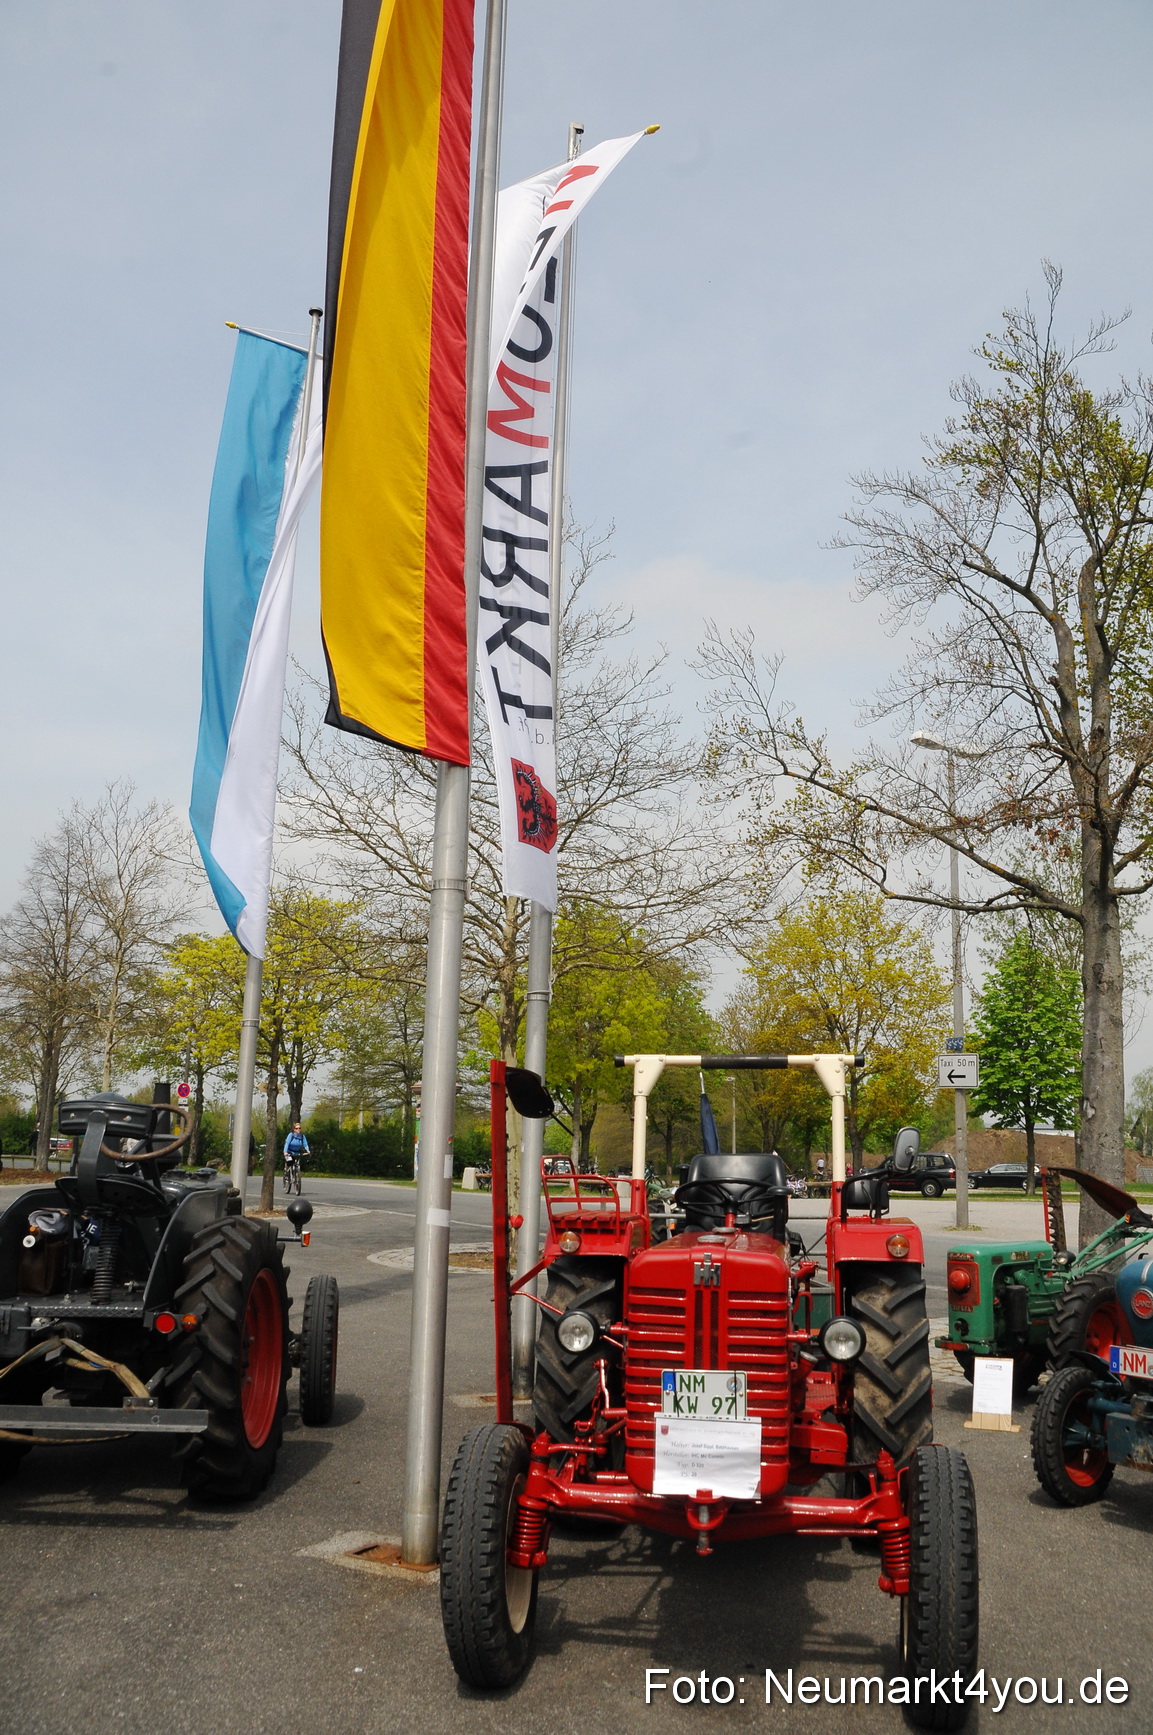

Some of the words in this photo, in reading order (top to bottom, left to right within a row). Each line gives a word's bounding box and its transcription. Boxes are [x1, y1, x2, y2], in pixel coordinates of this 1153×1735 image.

[940, 1059, 953, 1067] Taxi
[957, 1059, 967, 1067] 50
[1123, 1351, 1147, 1375] NM
[667, 1383, 673, 1391] D
[680, 1375, 705, 1393] NM
[673, 1395, 698, 1414] KW
[711, 1396, 736, 1415] 97
